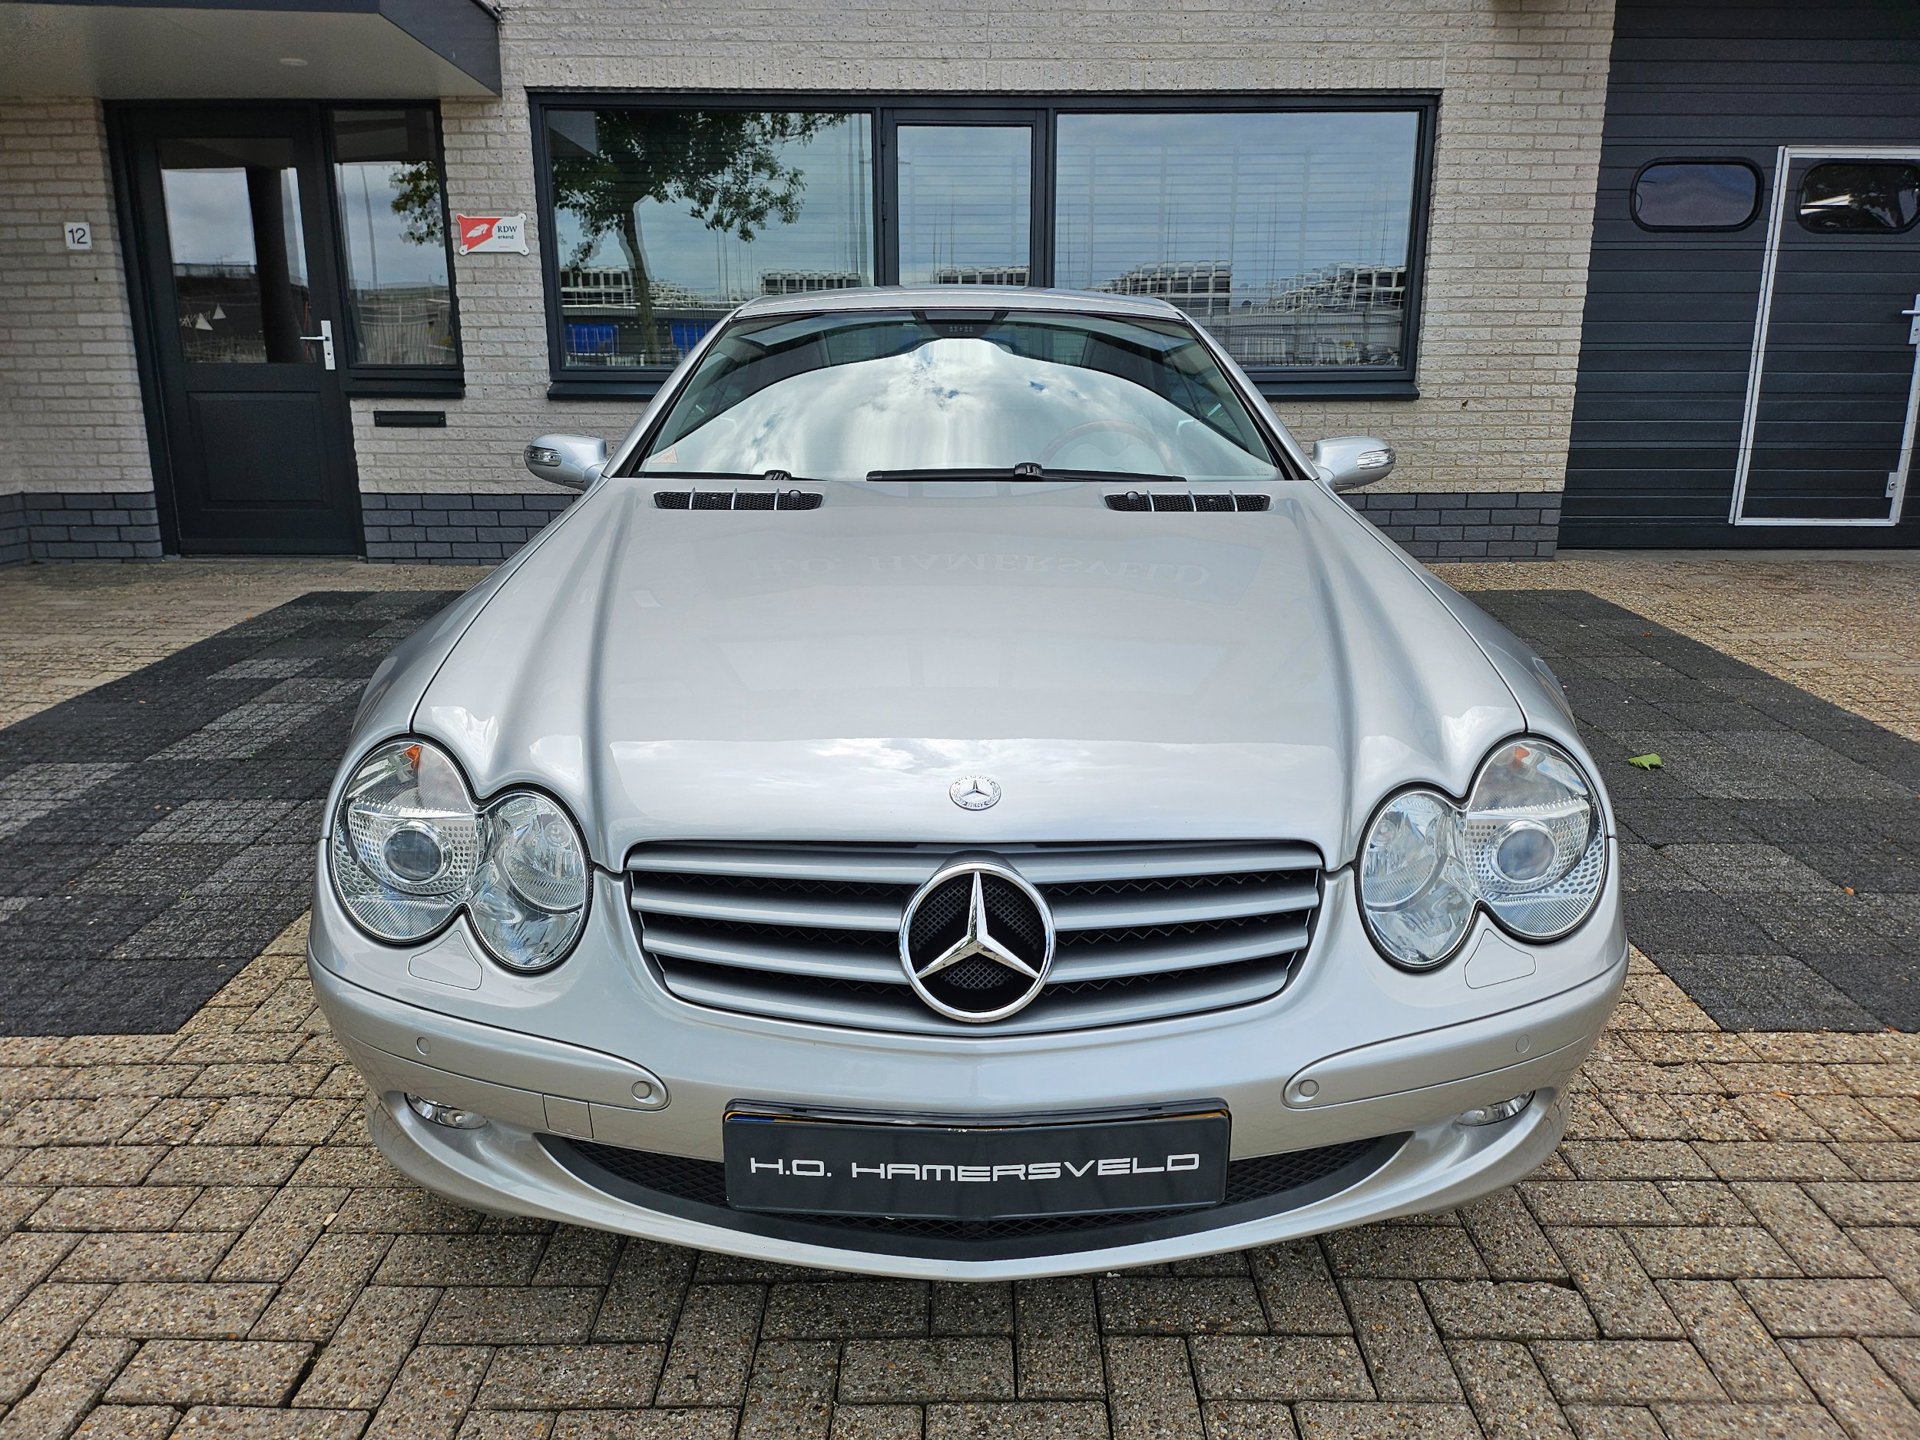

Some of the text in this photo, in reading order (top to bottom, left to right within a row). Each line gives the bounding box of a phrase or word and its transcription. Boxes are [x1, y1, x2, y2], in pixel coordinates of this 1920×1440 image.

[68, 227, 88, 244] 12
[497, 225, 517, 233] RDW
[750, 1153, 1200, 1182] H.O. HAMERSVELD
